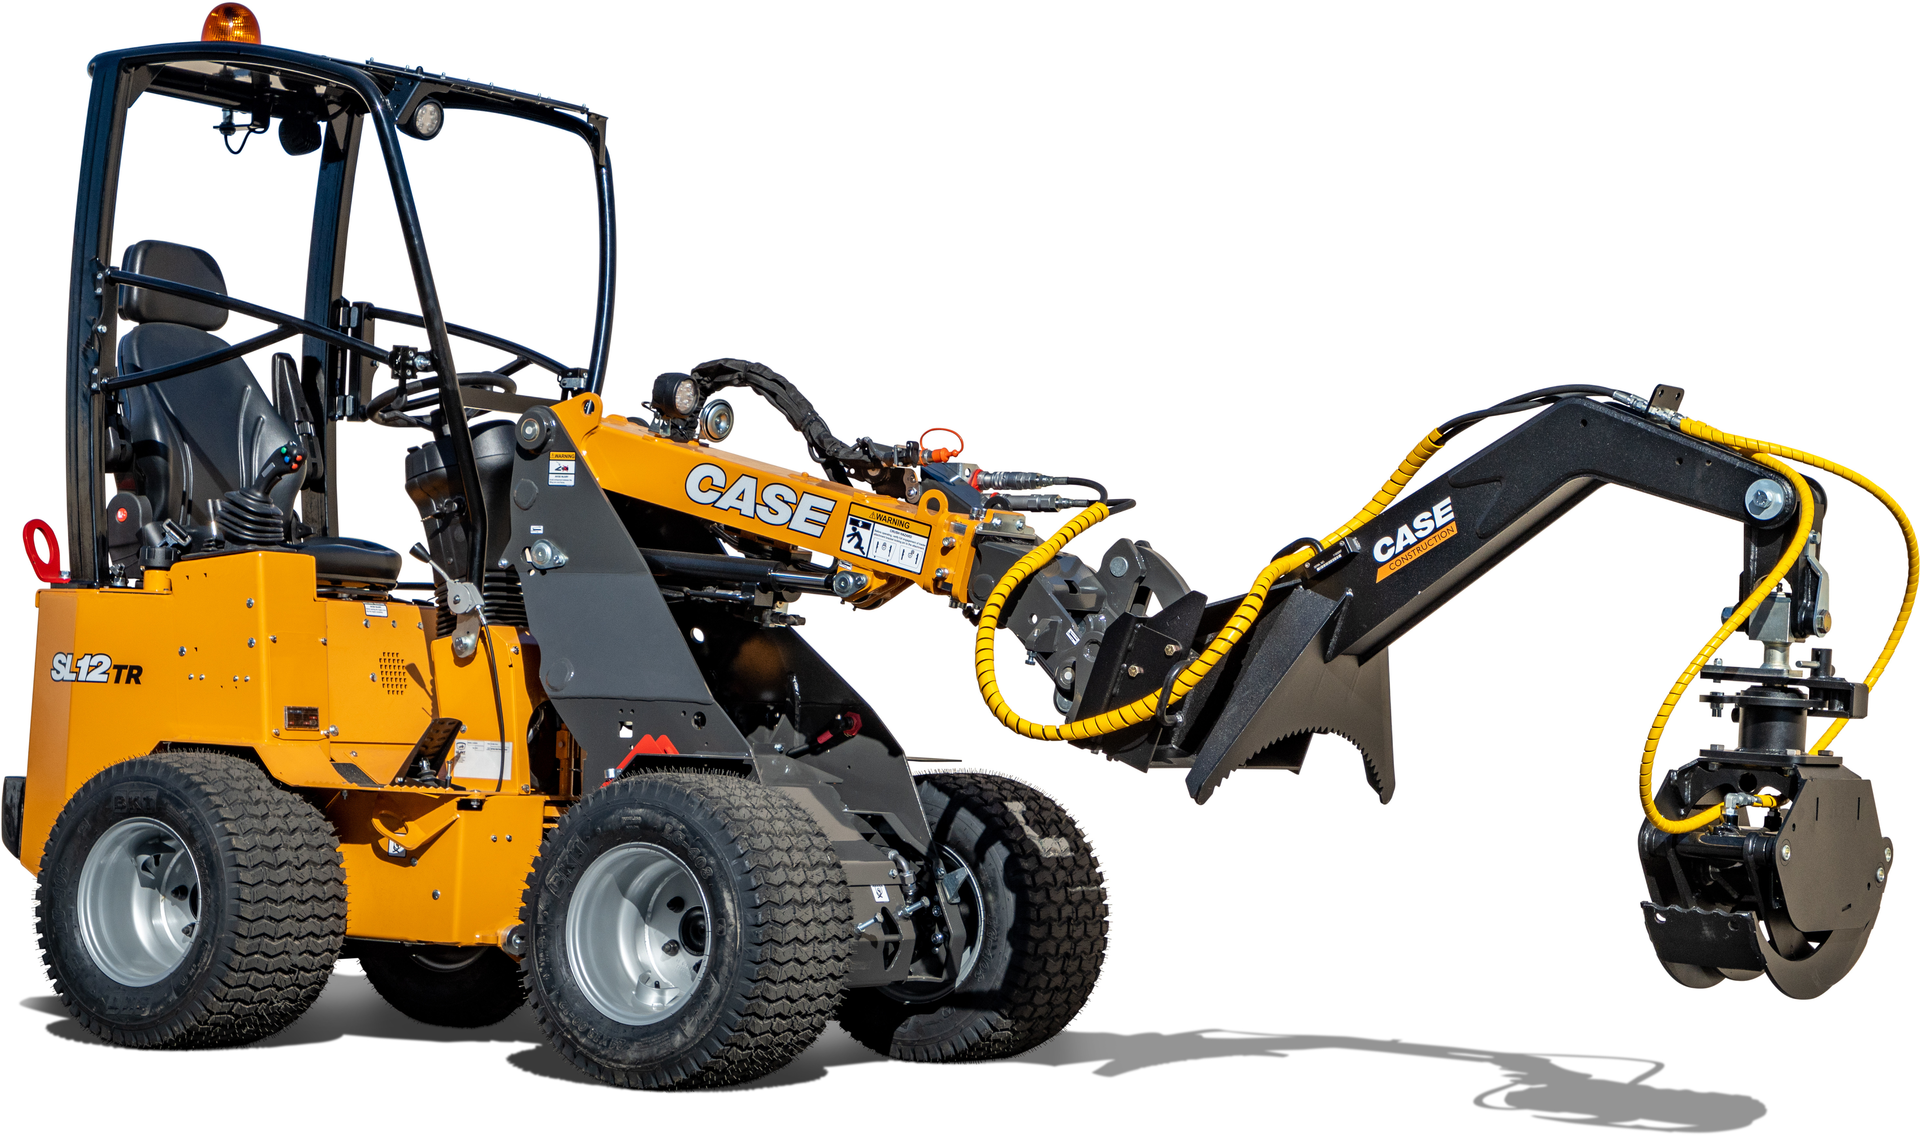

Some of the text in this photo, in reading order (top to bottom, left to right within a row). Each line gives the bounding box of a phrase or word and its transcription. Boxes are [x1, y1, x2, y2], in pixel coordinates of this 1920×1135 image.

[685, 463, 836, 537] CASE
[876, 513, 910, 529] WARNING
[1373, 496, 1455, 563] CASE
[1389, 527, 1454, 570] CONSTRUCTION
[51, 652, 143, 685] SL12 TR
